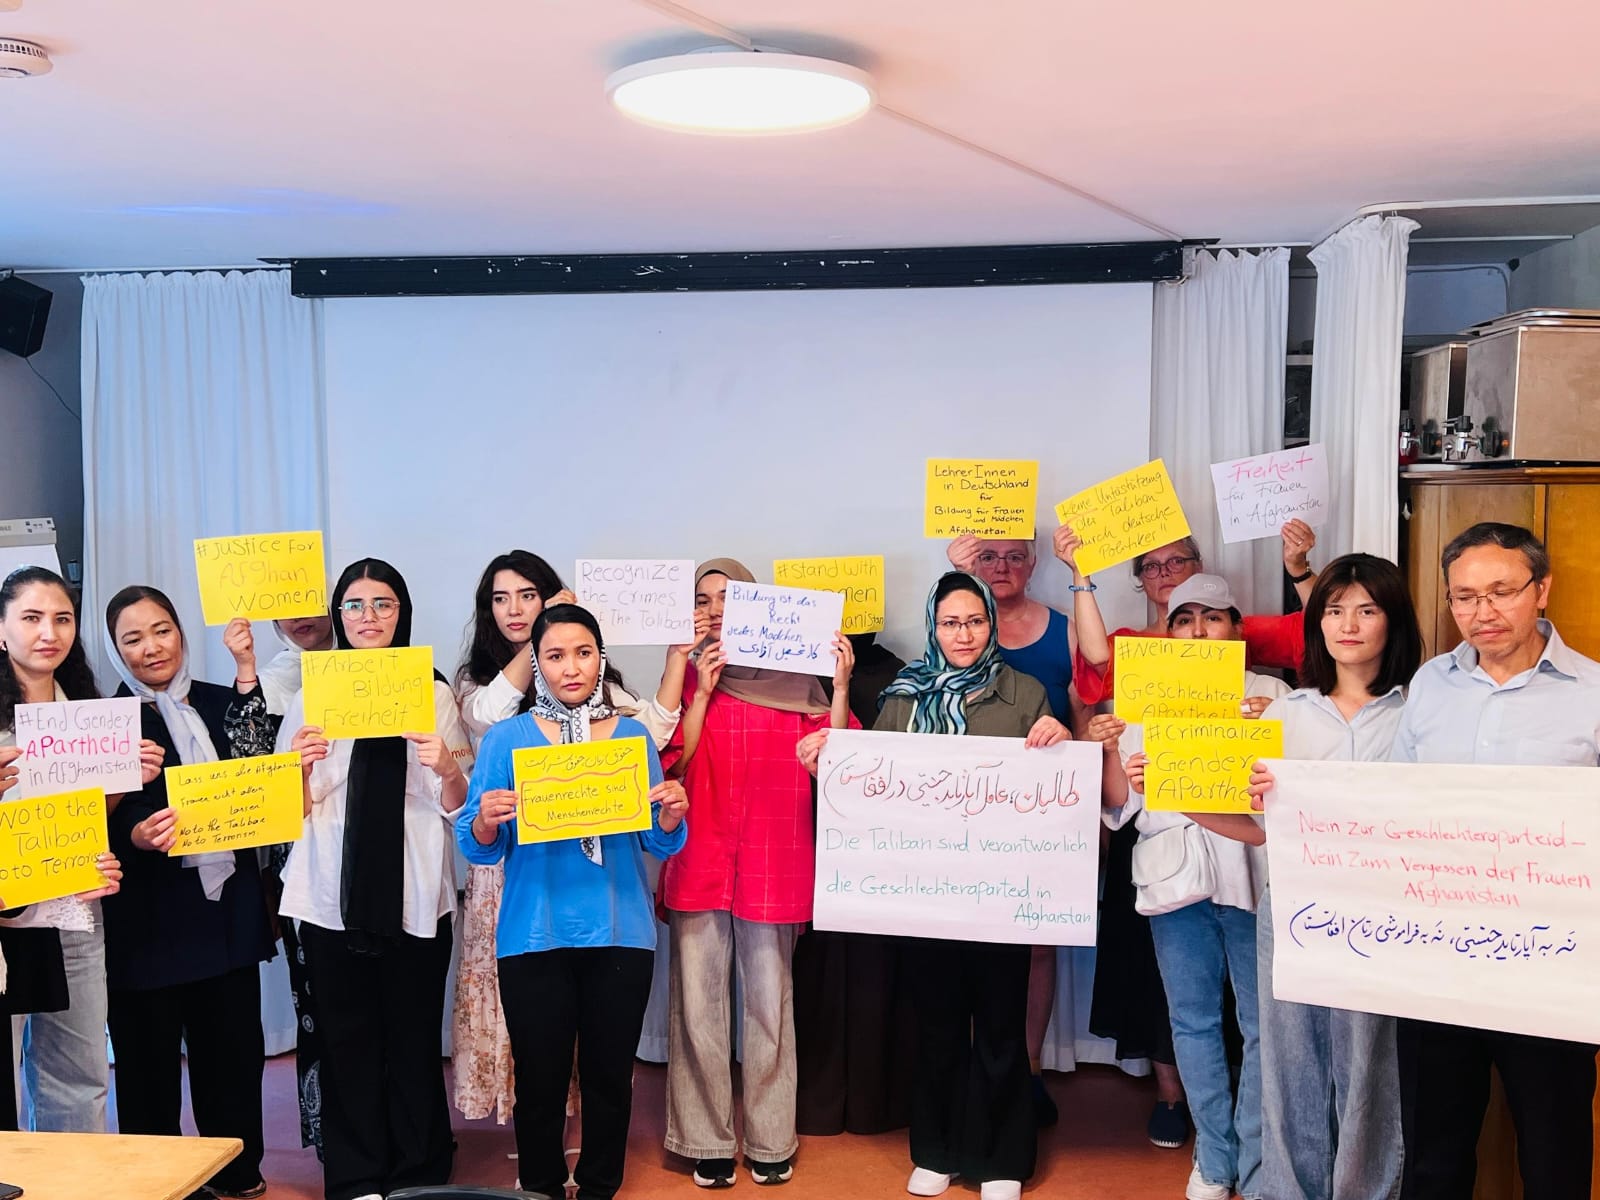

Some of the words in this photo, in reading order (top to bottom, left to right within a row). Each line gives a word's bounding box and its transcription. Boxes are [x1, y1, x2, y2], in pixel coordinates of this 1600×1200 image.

[1227, 450, 1312, 482] Freiheit
[943, 483, 954, 491] in
[960, 478, 1030, 491] Deutschland
[1254, 480, 1307, 498] Frauen
[934, 505, 972, 519] Bildung
[993, 506, 1025, 515] Frauen
[1062, 500, 1093, 517] Keine
[1076, 515, 1096, 531] der
[1110, 495, 1158, 517] Taliban
[1123, 504, 1177, 528] deutsche
[1230, 515, 1240, 526] in
[1246, 493, 1323, 528] Afghanistan
[220, 560, 309, 588] Afghan
[581, 561, 680, 584] Recognize
[581, 586, 608, 603] the
[733, 584, 776, 611] Bildung
[797, 597, 816, 608] das
[769, 609, 800, 625] Recht
[1118, 640, 1174, 660] #Nein
[353, 676, 424, 708] Bildung
[19, 704, 68, 731] #End
[74, 706, 134, 731] Gender
[323, 701, 409, 731] Freiheit
[1156, 750, 1255, 773] Gender
[28, 768, 44, 787] in
[178, 772, 203, 786] Lass
[210, 769, 228, 780] uns
[236, 763, 252, 777] die
[522, 784, 600, 807] Frauenrechte
[606, 776, 628, 794] sind
[66, 797, 99, 817] the
[546, 799, 625, 823] Menschenrechte
[178, 826, 191, 837] No
[193, 823, 204, 834] to
[207, 818, 221, 832] the
[224, 816, 266, 829] Taliban
[1298, 810, 1341, 835] Nein
[11, 822, 99, 857] Taliban
[181, 839, 193, 849] No
[195, 835, 206, 846] to
[212, 830, 257, 845] Terrorism
[825, 827, 861, 850] Die
[869, 827, 932, 851] Taliban
[936, 829, 970, 851] sind
[41, 852, 104, 878] Terroris
[1301, 843, 1343, 868] Nein
[1400, 856, 1478, 881] Vergessen
[1485, 853, 1524, 883] der
[1526, 861, 1594, 889] Frauen
[825, 868, 852, 894] die
[1036, 885, 1052, 899] in
[1403, 881, 1521, 908] Afghanistan
